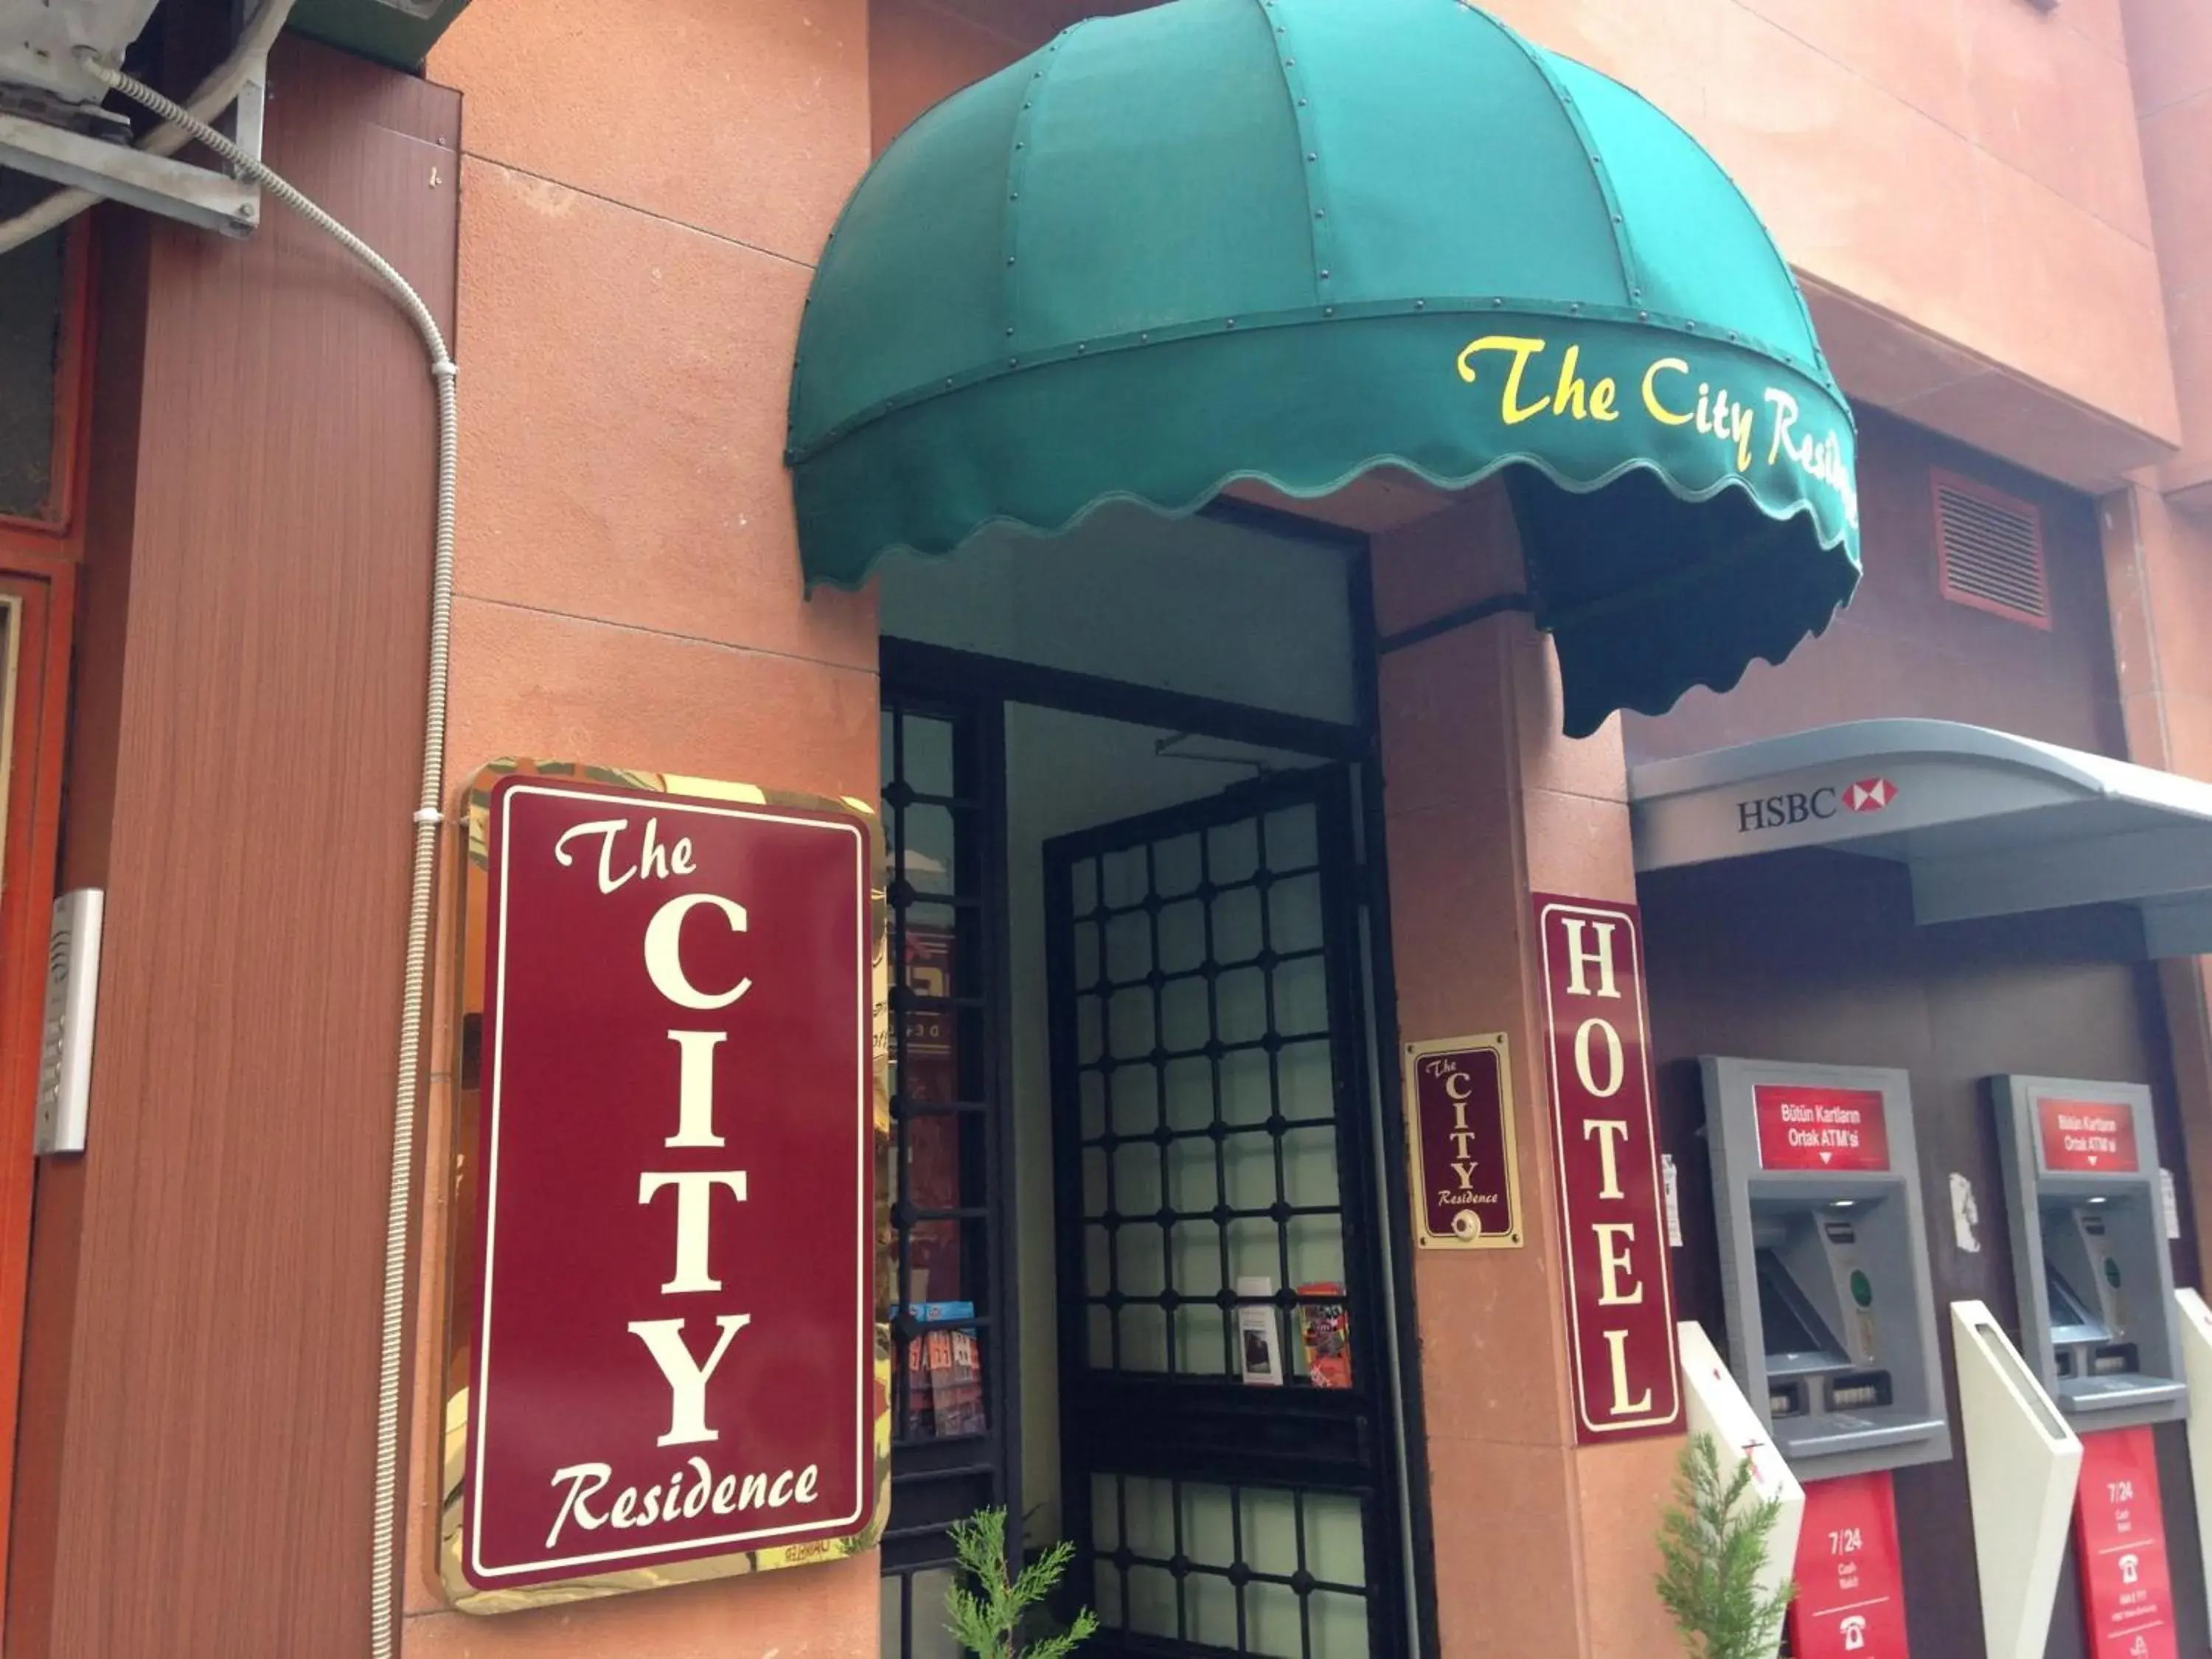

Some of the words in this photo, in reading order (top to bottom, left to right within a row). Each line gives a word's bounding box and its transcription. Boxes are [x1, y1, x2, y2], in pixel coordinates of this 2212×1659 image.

[1458, 335, 1620, 425] The
[1642, 358, 1755, 473] City
[1737, 787, 1837, 833] HSBC
[554, 817, 697, 894] The
[1425, 1059, 1457, 1077] The
[1445, 1073, 1479, 1189] CITY
[1781, 1104, 1814, 1123] Bütün
[1788, 1127, 1820, 1147] Ortak
[627, 893, 752, 1447] CITY
[1438, 1189, 1498, 1206] Residence
[1561, 918, 1652, 1416] HOTEL
[546, 1456, 818, 1548] Residence
[1828, 1527, 1863, 1556] 7/24
